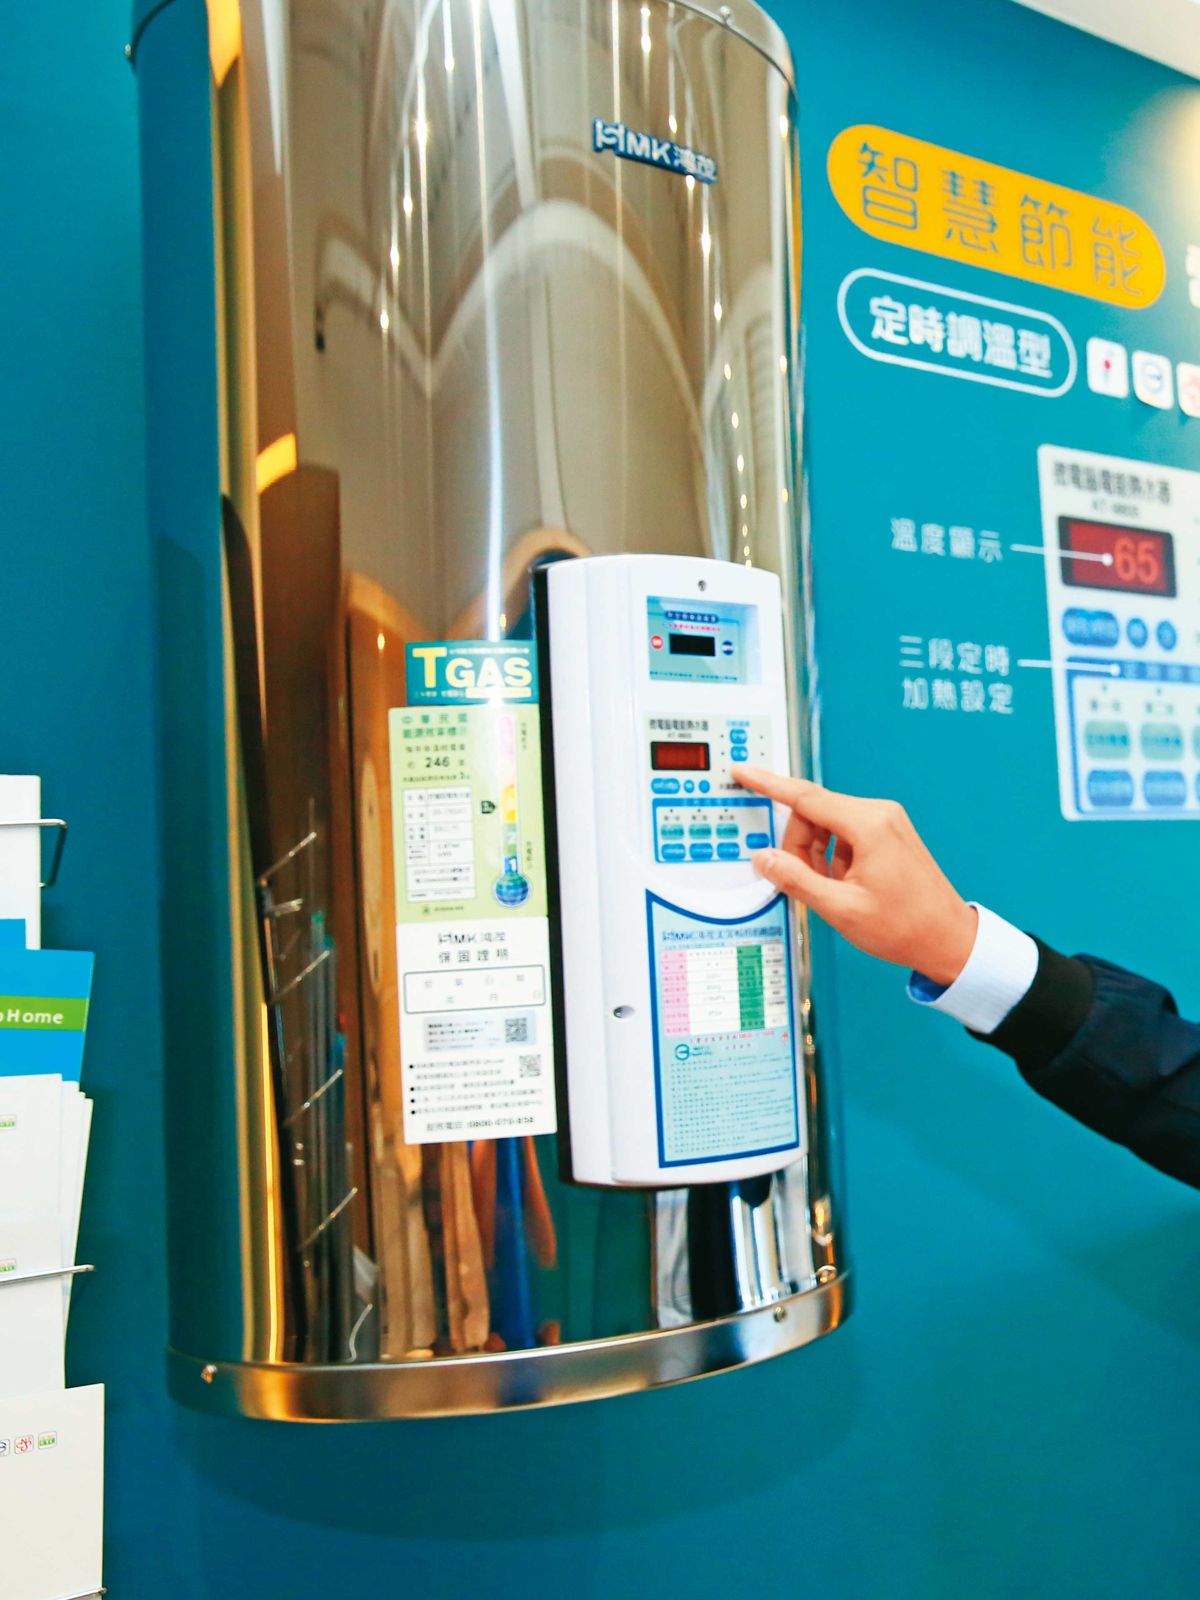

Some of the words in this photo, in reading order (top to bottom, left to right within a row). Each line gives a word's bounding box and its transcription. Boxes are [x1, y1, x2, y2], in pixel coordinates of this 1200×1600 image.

[857, 142, 1144, 296] 智慧節能
[868, 295, 1053, 378] 定時調溫型
[890, 517, 1003, 563] 溫度顯示
[1113, 537, 1160, 584] 65
[412, 647, 532, 688] TGAS
[899, 635, 1010, 676] 三段定時
[902, 677, 1014, 714] 加熱設定
